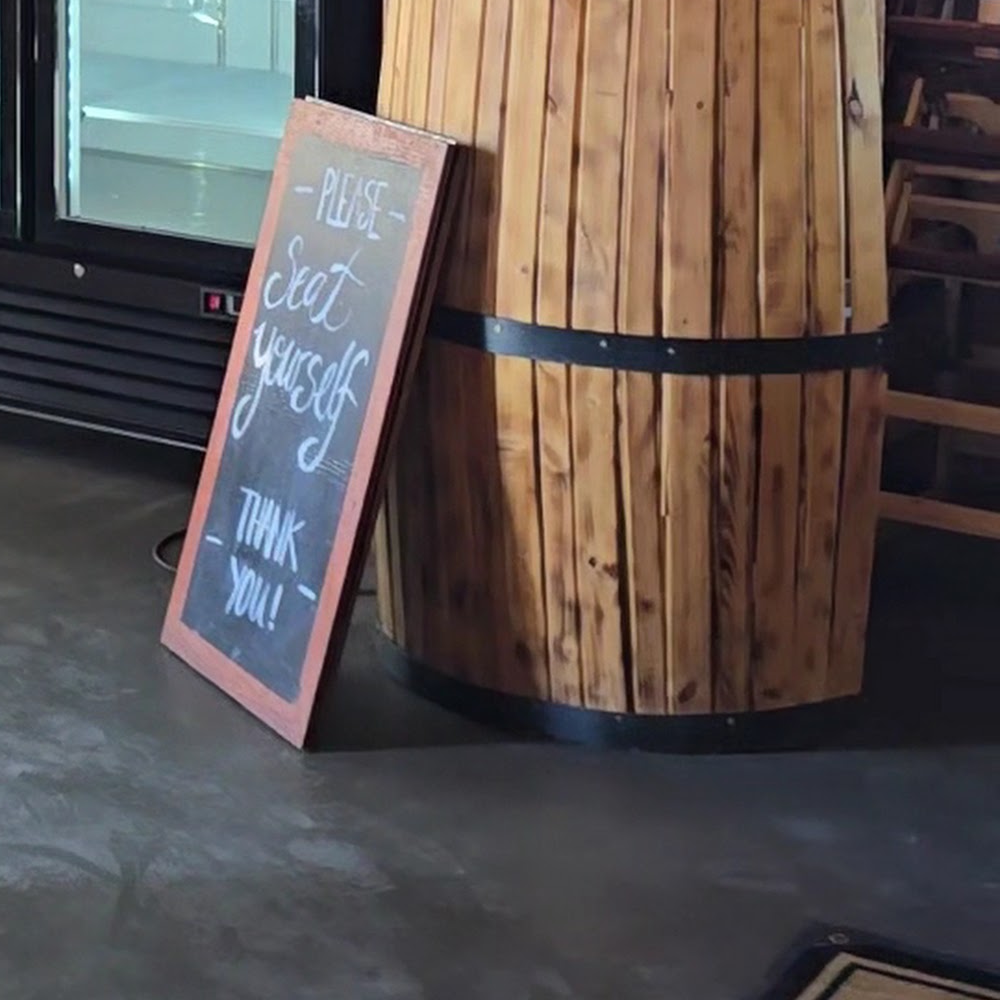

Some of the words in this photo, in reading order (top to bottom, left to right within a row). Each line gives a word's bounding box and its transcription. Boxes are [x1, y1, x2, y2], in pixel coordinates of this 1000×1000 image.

[316, 167, 388, 241] PLEASE
[263, 235, 366, 332] Seat
[231, 321, 370, 473] yourself
[240, 486, 306, 573] THANK
[225, 555, 284, 632] YOU!
